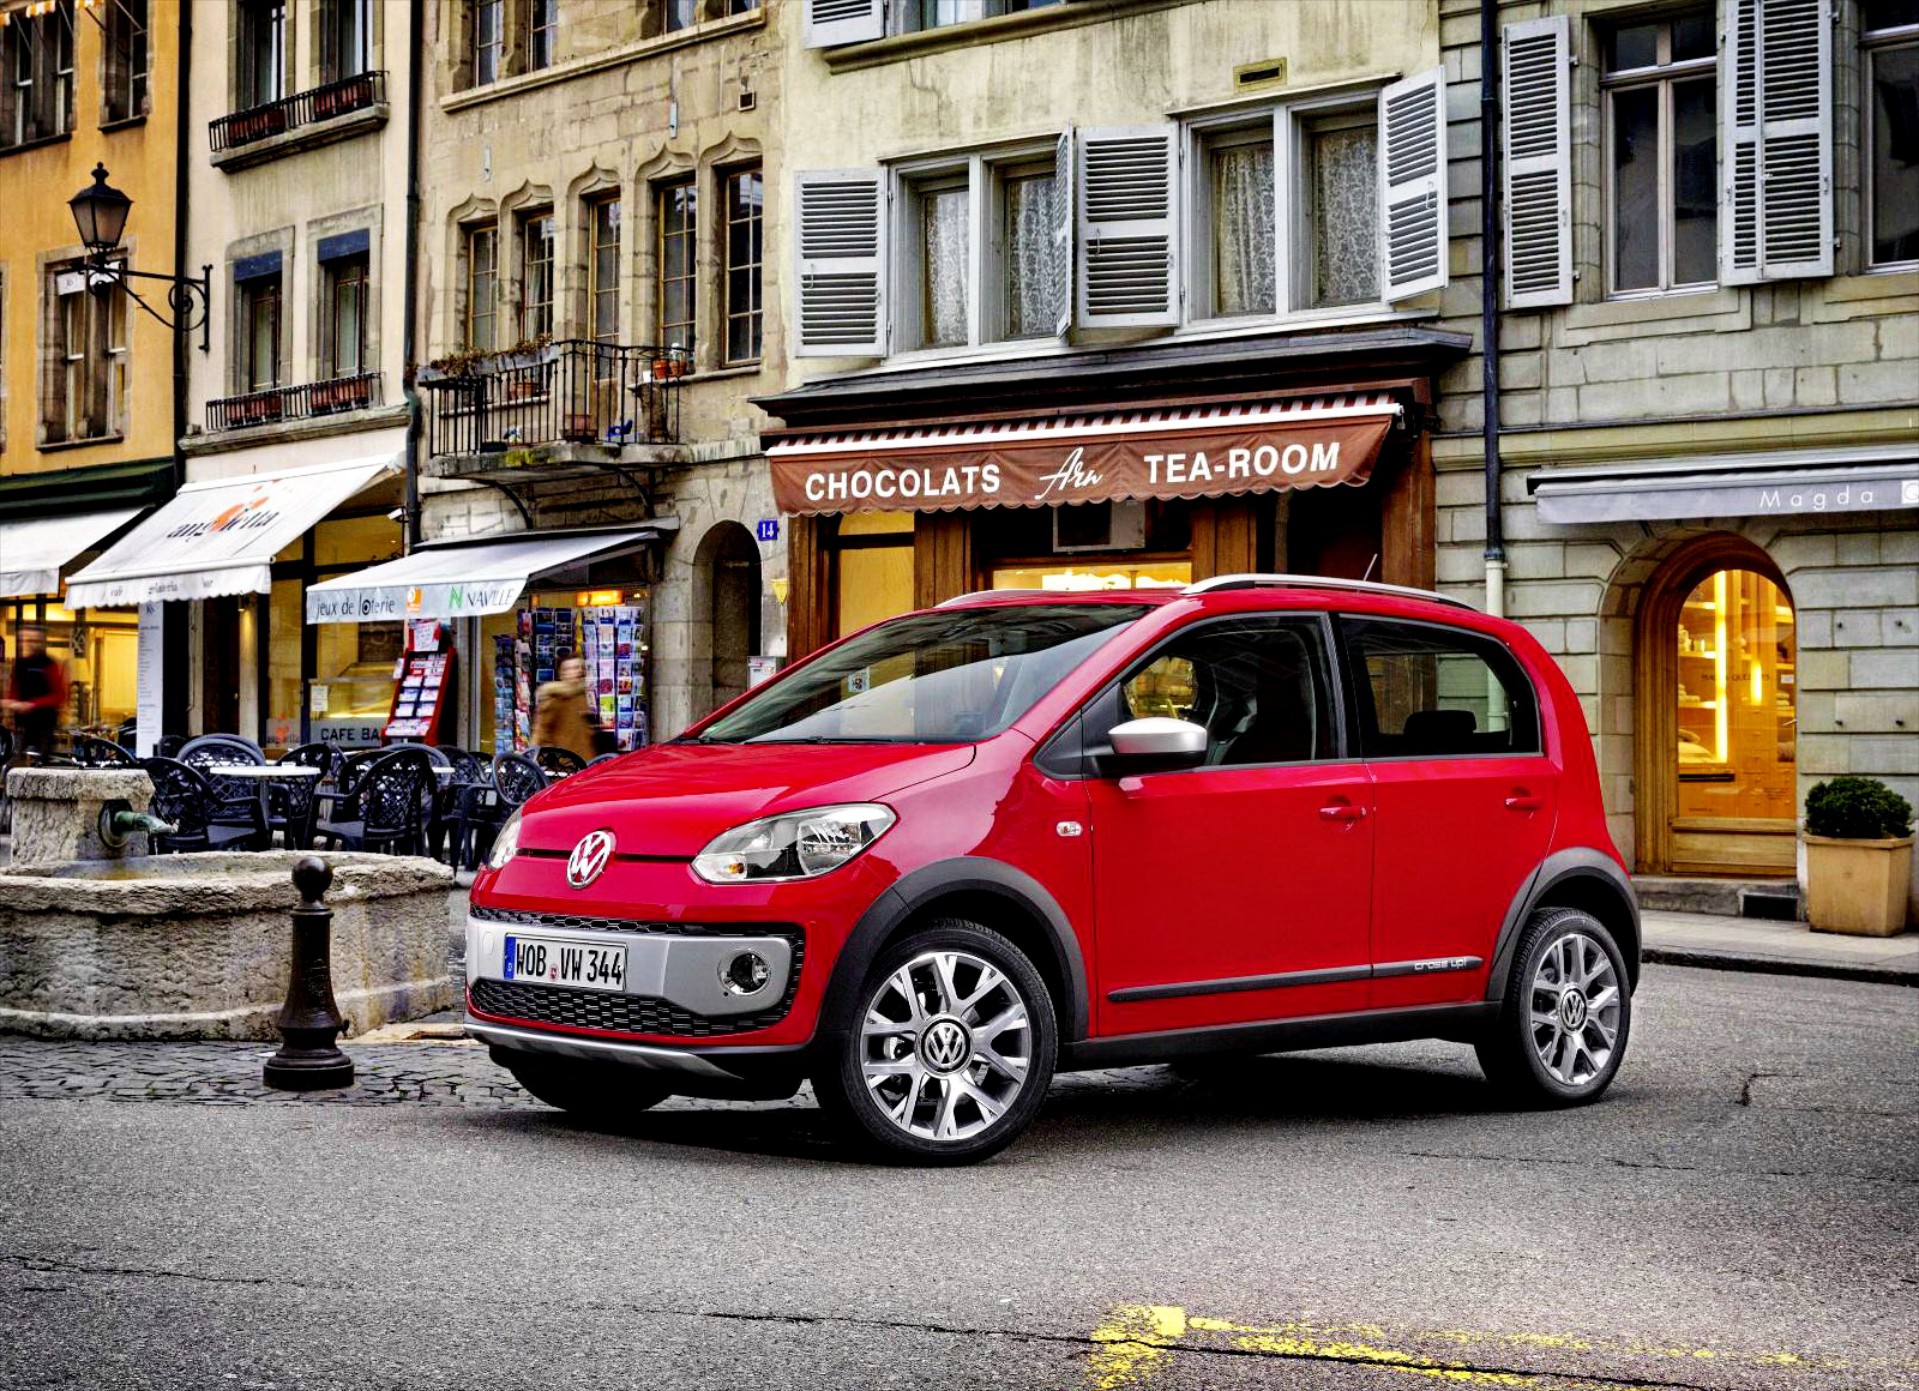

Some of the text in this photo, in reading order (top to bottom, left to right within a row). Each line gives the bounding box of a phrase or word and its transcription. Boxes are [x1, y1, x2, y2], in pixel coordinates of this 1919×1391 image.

[805, 464, 1000, 500] CHOCOLATS
[1144, 442, 1340, 484] TEA-ROOM
[1759, 484, 1874, 511] Magda
[762, 522, 775, 538] 14
[316, 600, 337, 618] jeux
[341, 597, 354, 616] de
[358, 594, 395, 616] loterie
[467, 588, 515, 608] NAVILLE
[320, 728, 356, 741] CAFE
[516, 943, 622, 985] WOB VW 344
[1414, 960, 1448, 971] cross
